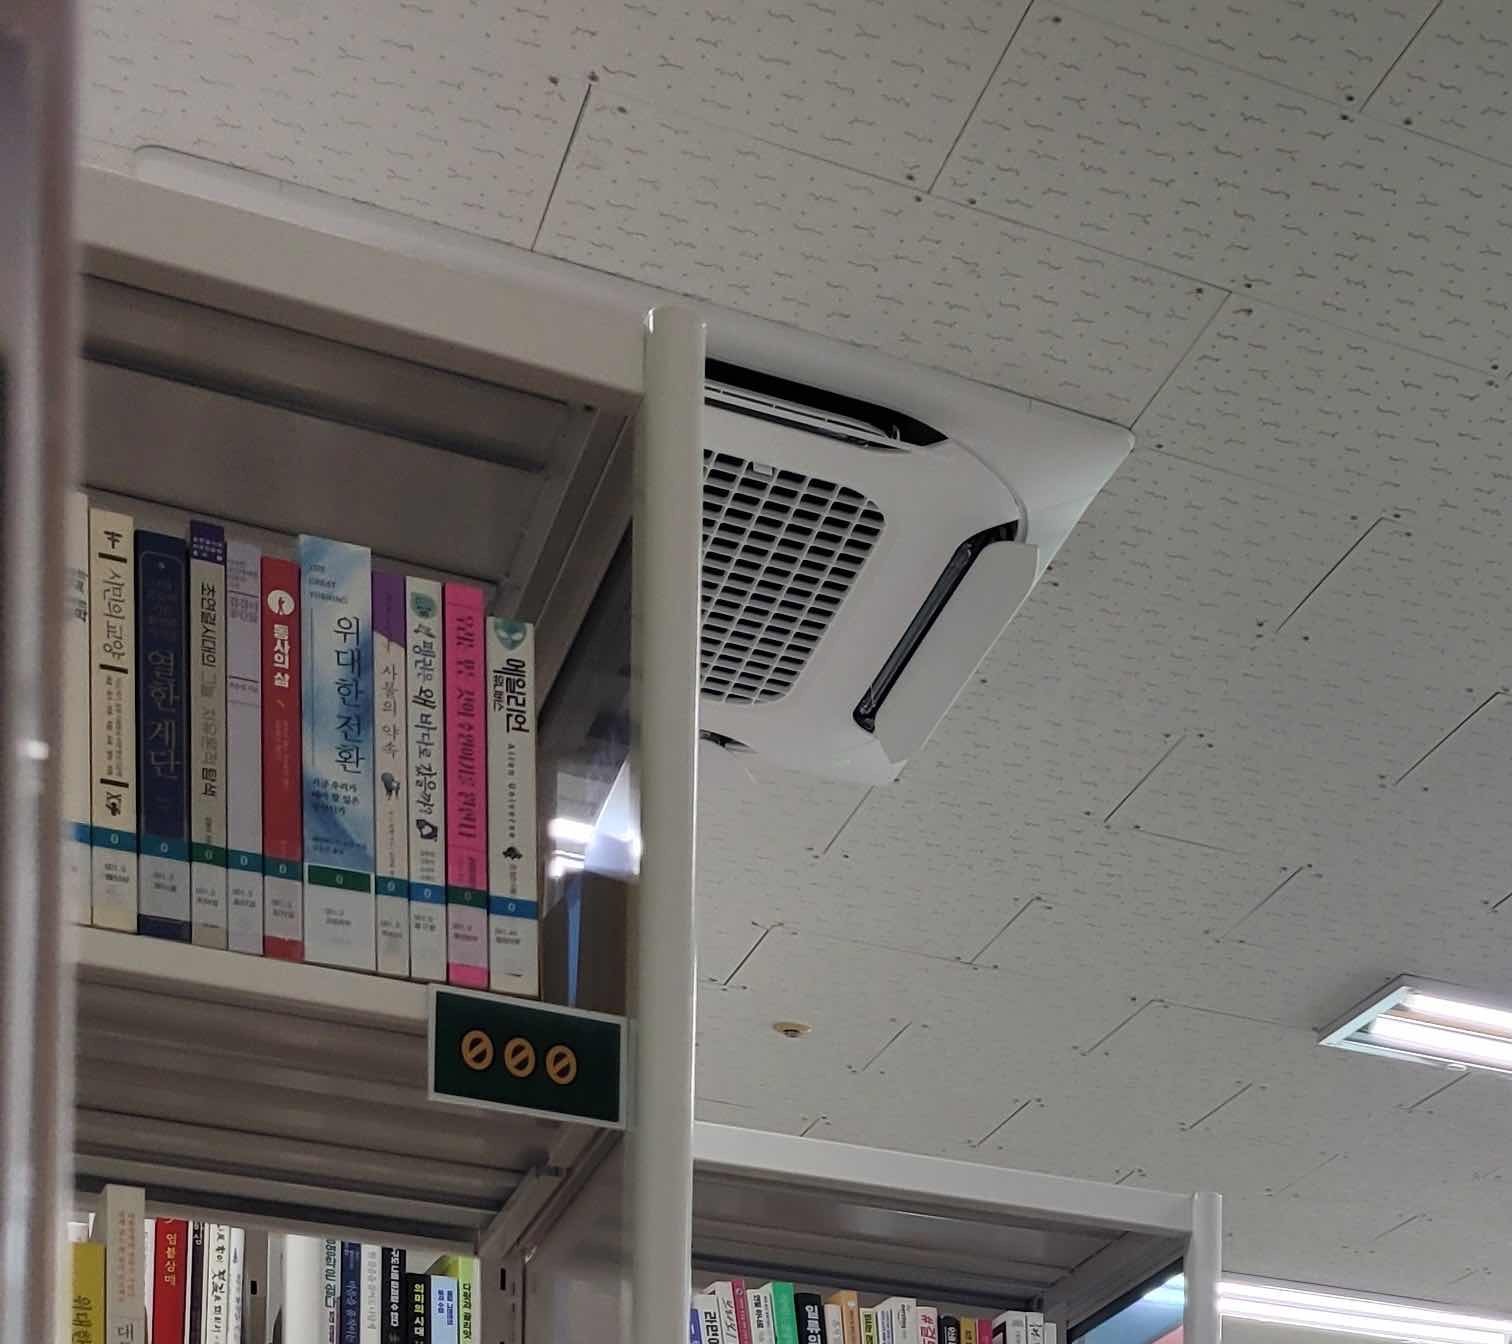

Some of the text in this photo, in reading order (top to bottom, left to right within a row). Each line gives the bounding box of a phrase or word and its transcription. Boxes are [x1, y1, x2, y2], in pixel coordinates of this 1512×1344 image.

[103, 569, 126, 661] 시민의 교양
[201, 582, 217, 667] 초연결시대의
[334, 615, 361, 708] 위대한
[412, 687, 437, 711] 왜
[494, 658, 530, 734] 에일리언
[335, 715, 362, 775] 전환
[414, 713, 437, 761] 바다로
[415, 763, 438, 816] 갔을까?
[507, 743, 516, 839] Alien Universe
[461, 1029, 578, 1085] 000
